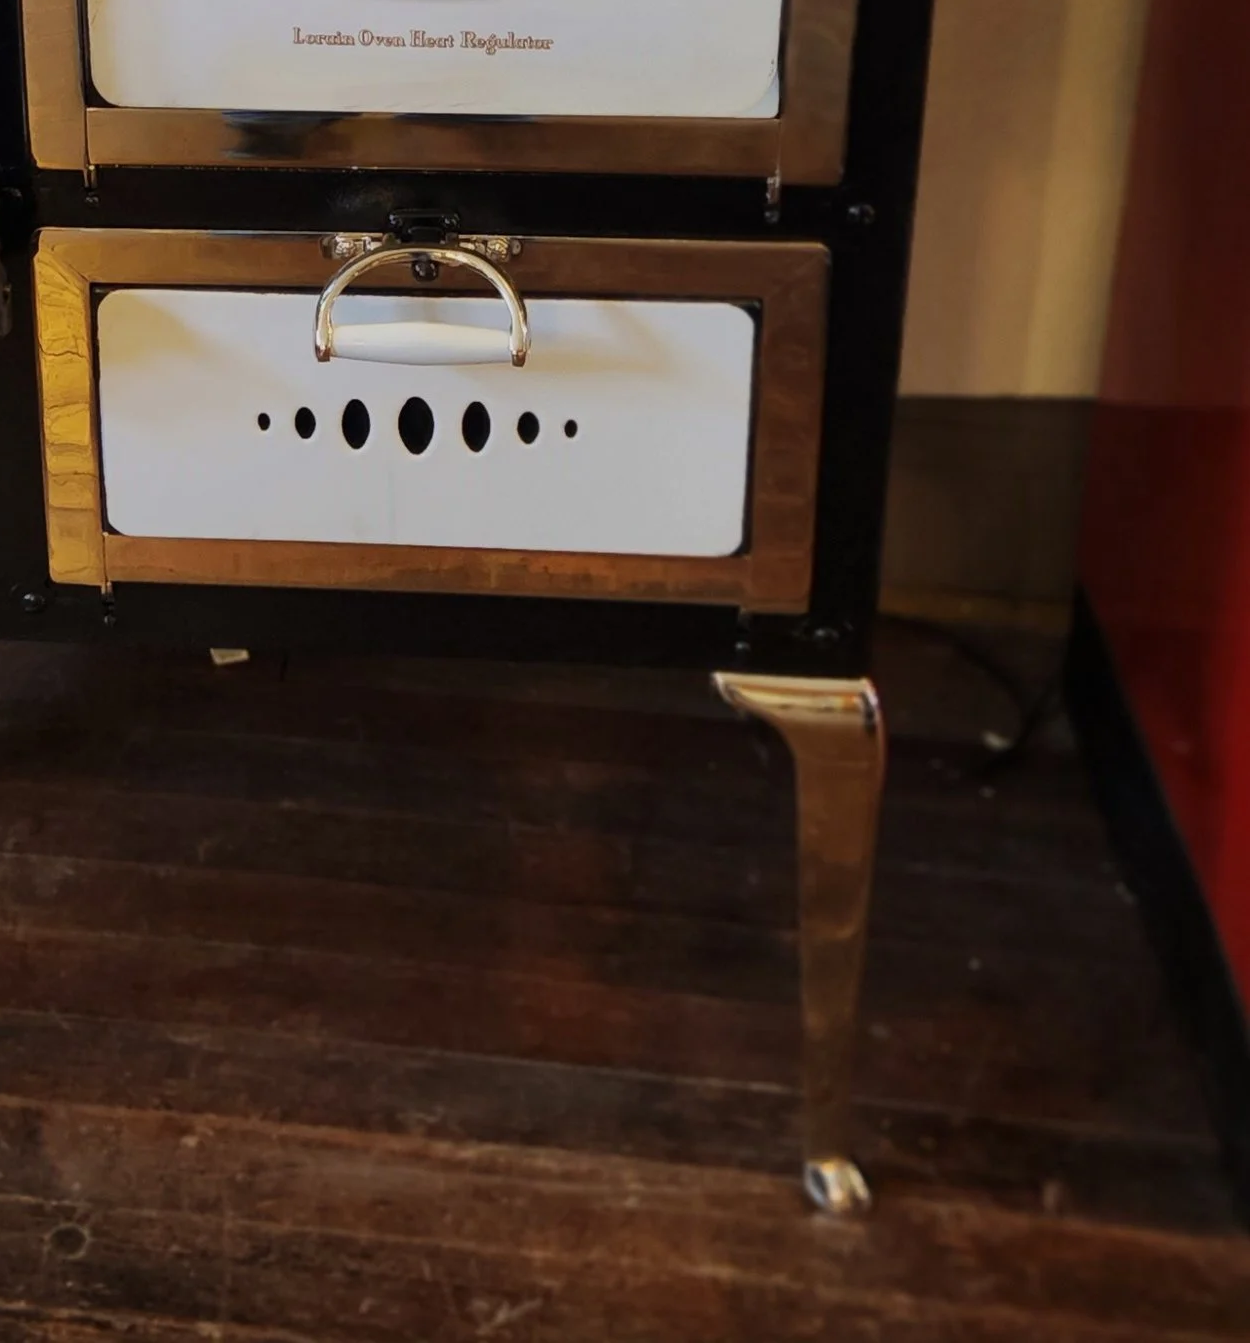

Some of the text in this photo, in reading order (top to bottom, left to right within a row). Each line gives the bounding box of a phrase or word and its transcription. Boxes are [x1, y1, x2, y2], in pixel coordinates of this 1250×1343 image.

[293, 27, 554, 55] Lorain Oven Heat Regulator
